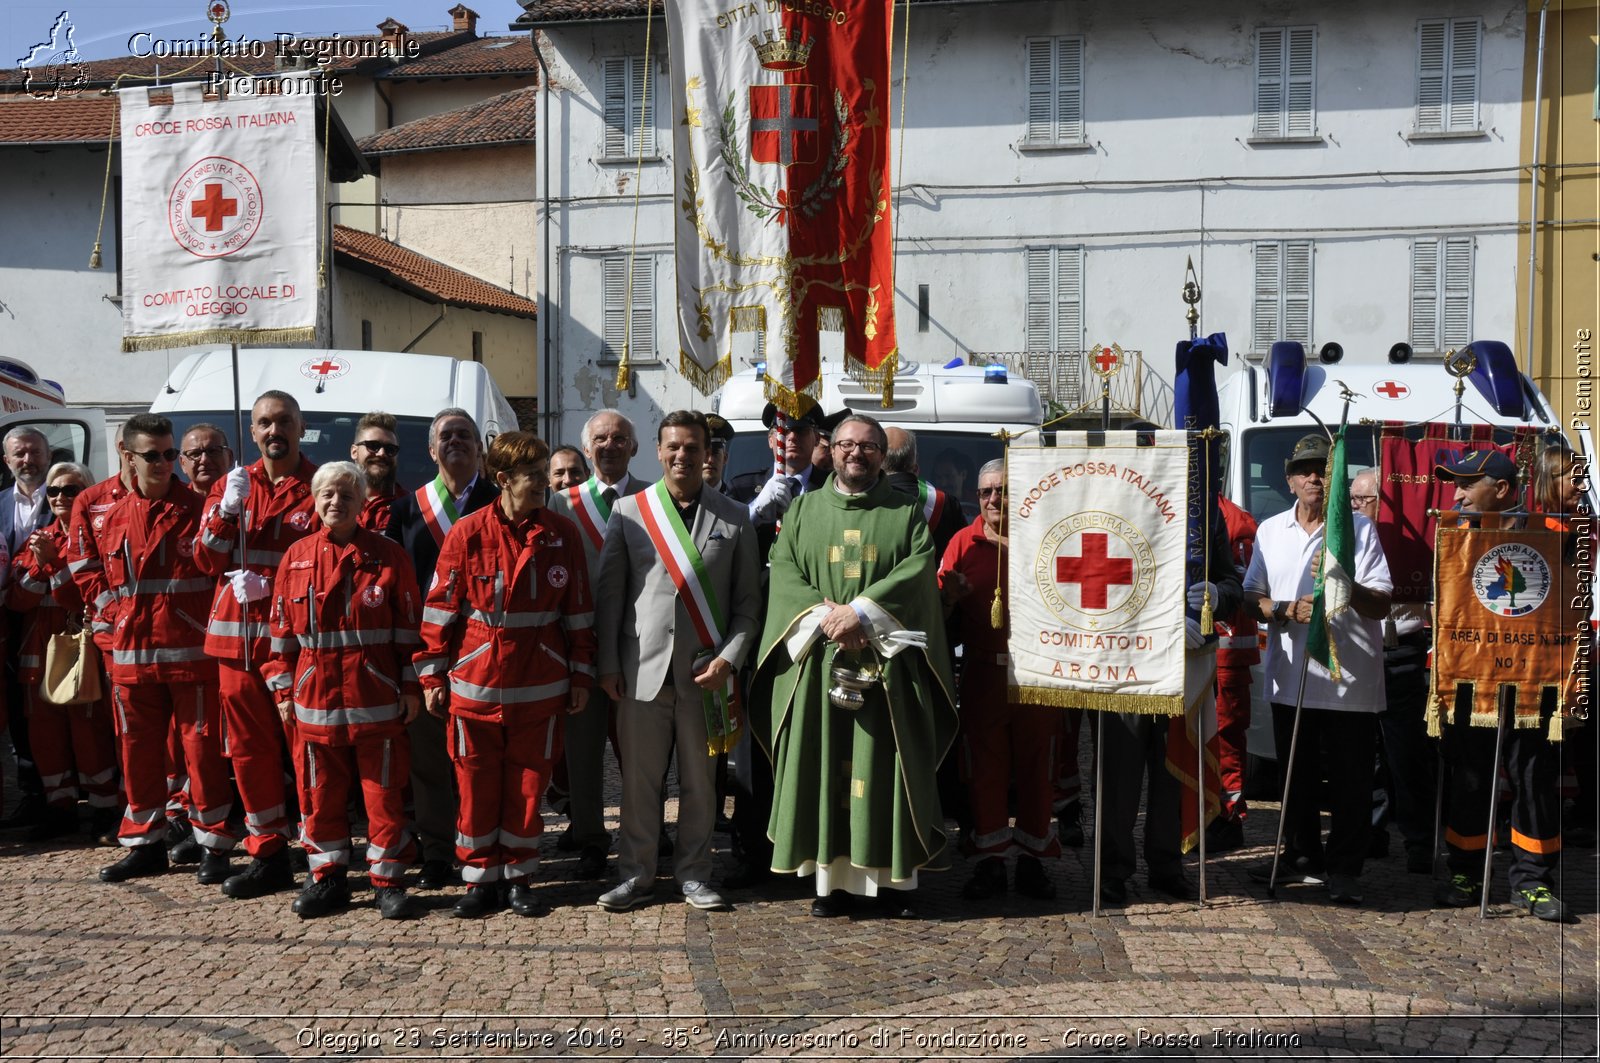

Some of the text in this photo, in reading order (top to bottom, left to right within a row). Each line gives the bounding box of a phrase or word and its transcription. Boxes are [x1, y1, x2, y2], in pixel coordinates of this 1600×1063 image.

[768, 0, 781, 13] DI
[784, 0, 845, 25] OLEGGIO
[136, 111, 296, 137] CROCE ROSSA ITALIANA
[175, 163, 257, 250] CONVENZIONE DI GINEVRA 22 AGOSTO 1864
[144, 285, 295, 307] COMITATO LOCALE DI
[186, 302, 248, 317] OLEGGIO
[1018, 462, 1176, 524] CROCE ROSSA ITALIANA
[1038, 531, 1065, 613] CONVENZIONE
[1060, 522, 1072, 536] DI
[1072, 515, 1122, 532] GINEVRA
[1124, 527, 1139, 541] 22
[1135, 542, 1153, 592] AGOSTO
[1480, 545, 1520, 567] VOLONTARI
[1476, 567, 1485, 596] CORPO
[1538, 560, 1550, 599] PIEMONTE
[1040, 630, 1152, 650] COMITATO DI
[1450, 631, 1481, 642] AREA
[1488, 632, 1498, 643] DI
[1504, 632, 1535, 645] BASE
[1052, 661, 1138, 681] ARONA
[1495, 657, 1527, 668] NO 1
